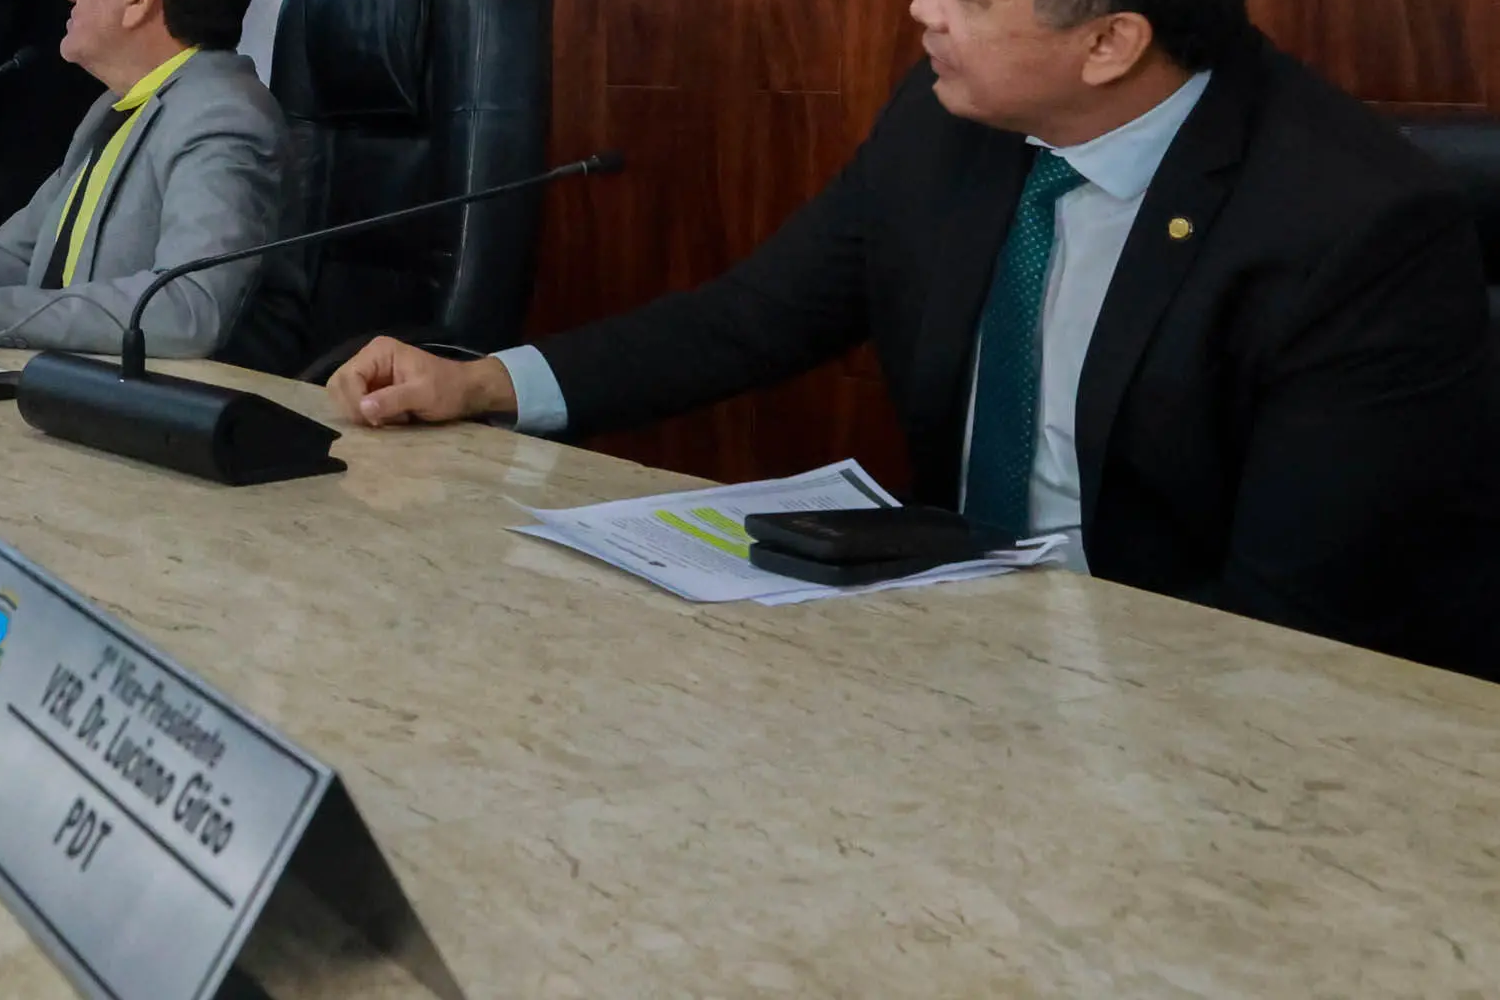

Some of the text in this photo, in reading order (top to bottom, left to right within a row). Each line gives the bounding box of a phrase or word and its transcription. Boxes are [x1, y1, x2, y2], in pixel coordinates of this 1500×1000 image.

[41, 663, 85, 730] VER.
[77, 696, 108, 751] Dr.
[104, 716, 177, 807] Luciano
[174, 772, 236, 856] Girão
[52, 796, 114, 873] PDT
